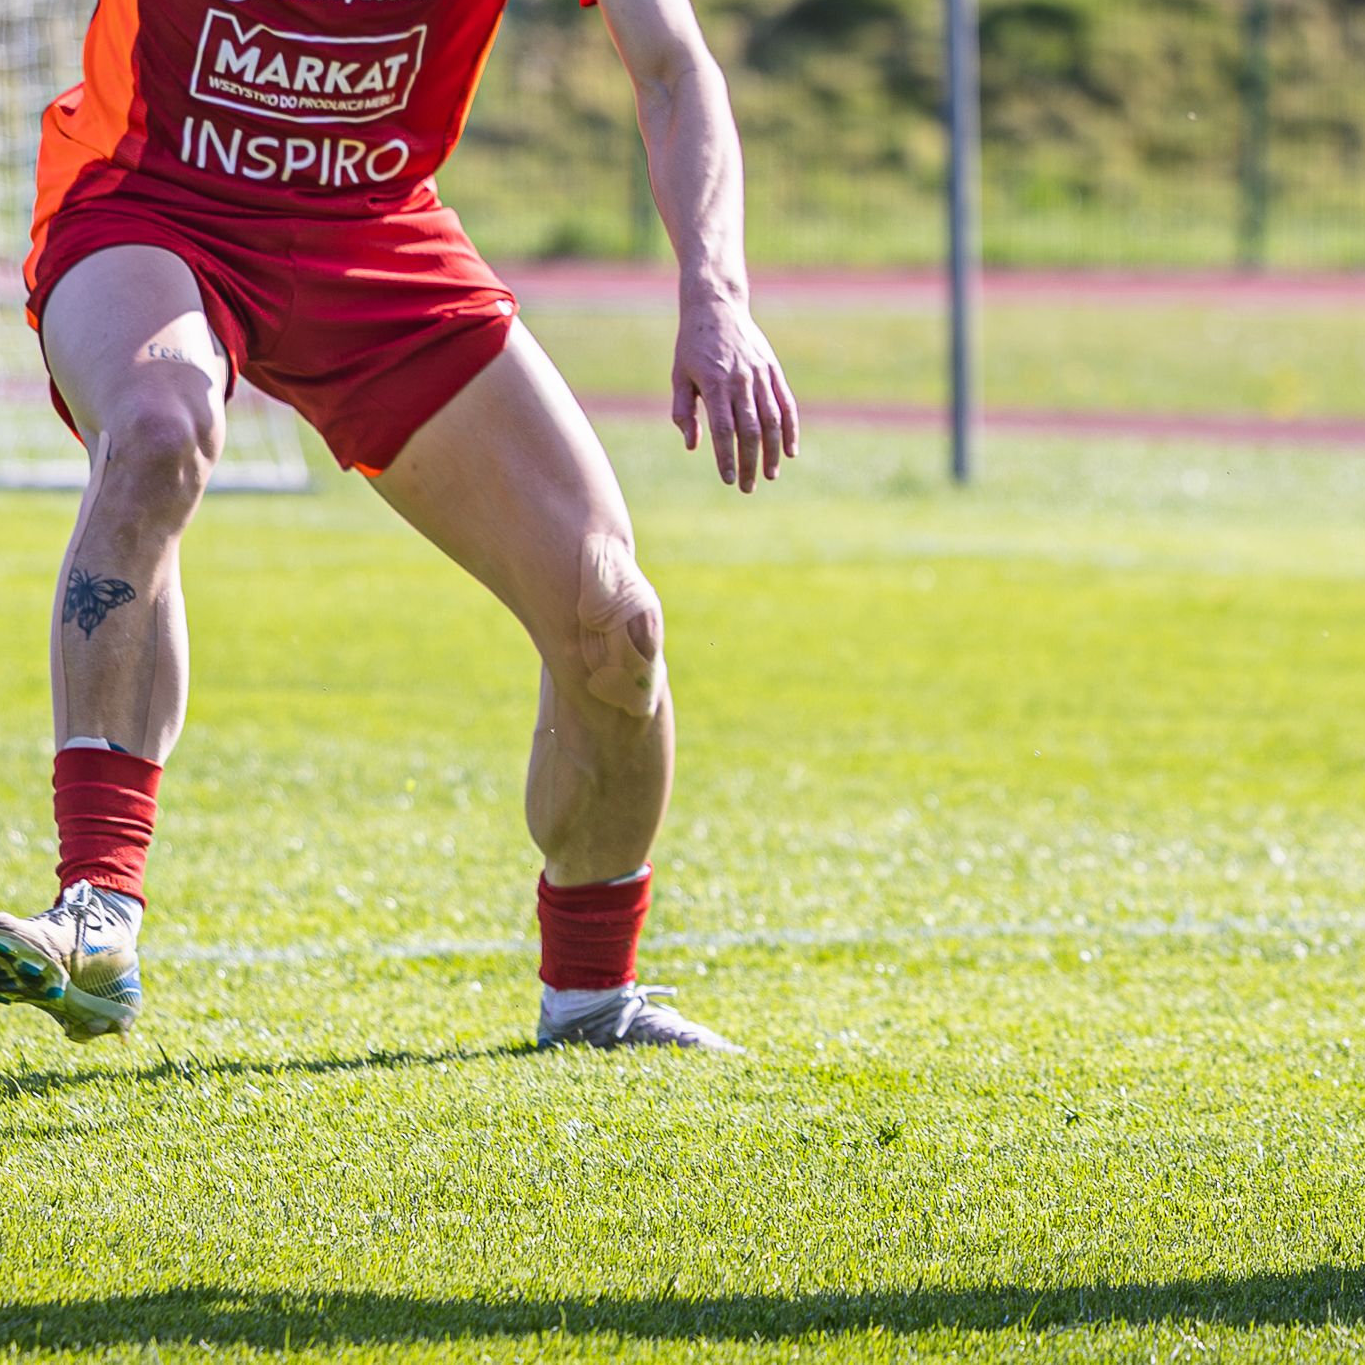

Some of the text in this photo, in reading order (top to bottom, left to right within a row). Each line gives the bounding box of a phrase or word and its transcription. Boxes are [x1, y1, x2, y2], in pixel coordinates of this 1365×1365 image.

[214, 39, 409, 95] MARKAT
[279, 94, 297, 109] DO
[180, 116, 410, 187] INSPIRO
